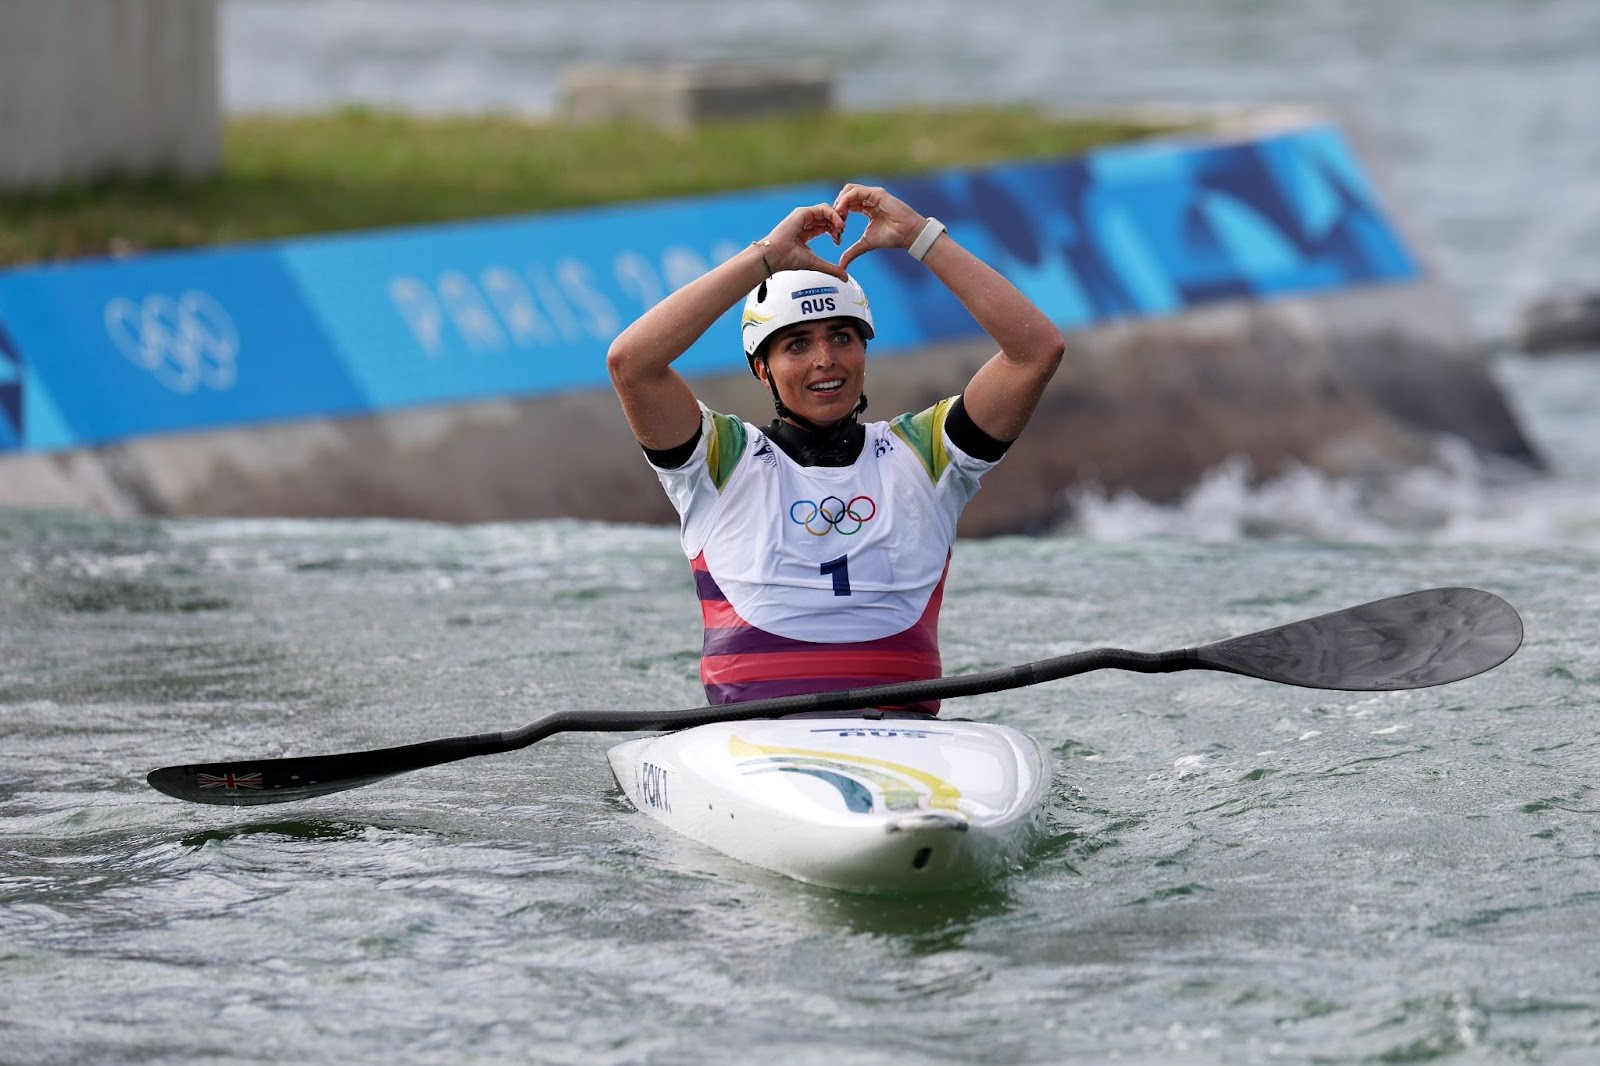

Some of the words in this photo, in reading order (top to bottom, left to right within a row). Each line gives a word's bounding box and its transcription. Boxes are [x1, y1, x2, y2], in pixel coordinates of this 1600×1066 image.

[390, 256, 621, 358] PARIS
[801, 297, 836, 315] AUS
[820, 554, 851, 596] 1
